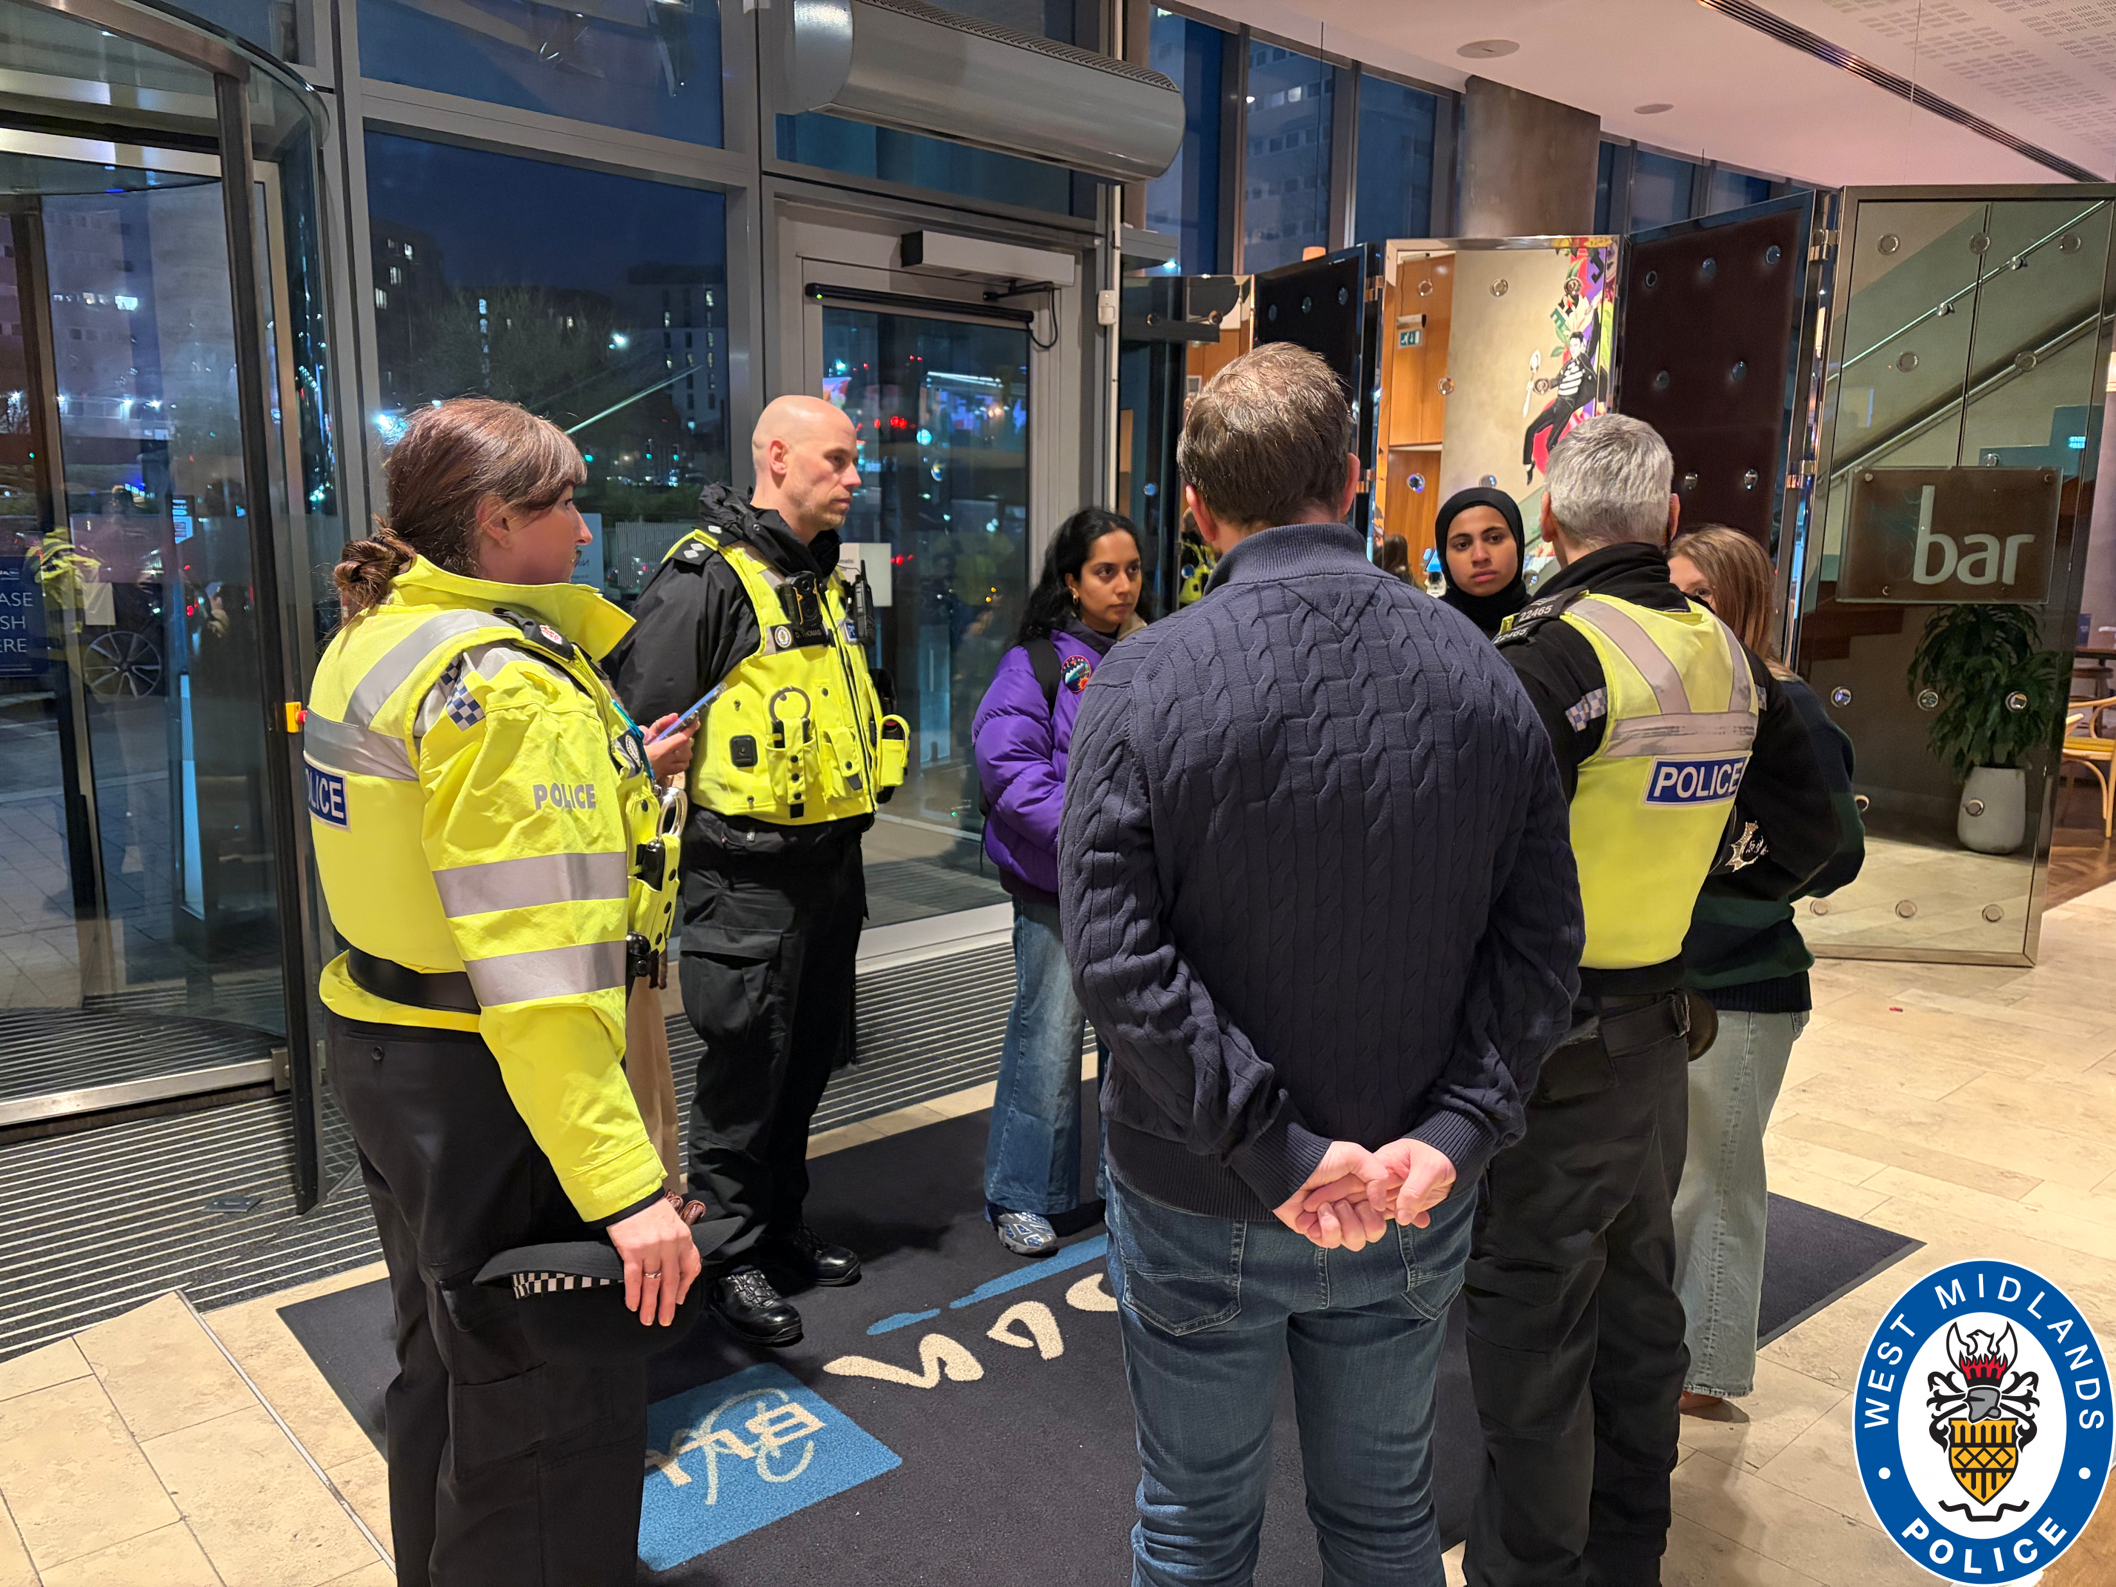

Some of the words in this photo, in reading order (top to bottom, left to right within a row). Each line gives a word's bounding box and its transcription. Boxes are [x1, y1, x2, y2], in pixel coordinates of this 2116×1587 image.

[1913, 485, 2036, 586] bar
[1518, 604, 1554, 622] 22465
[0, 638, 27, 653] RE
[1653, 762, 1744, 798] POLICE
[533, 783, 596, 810] POLICE
